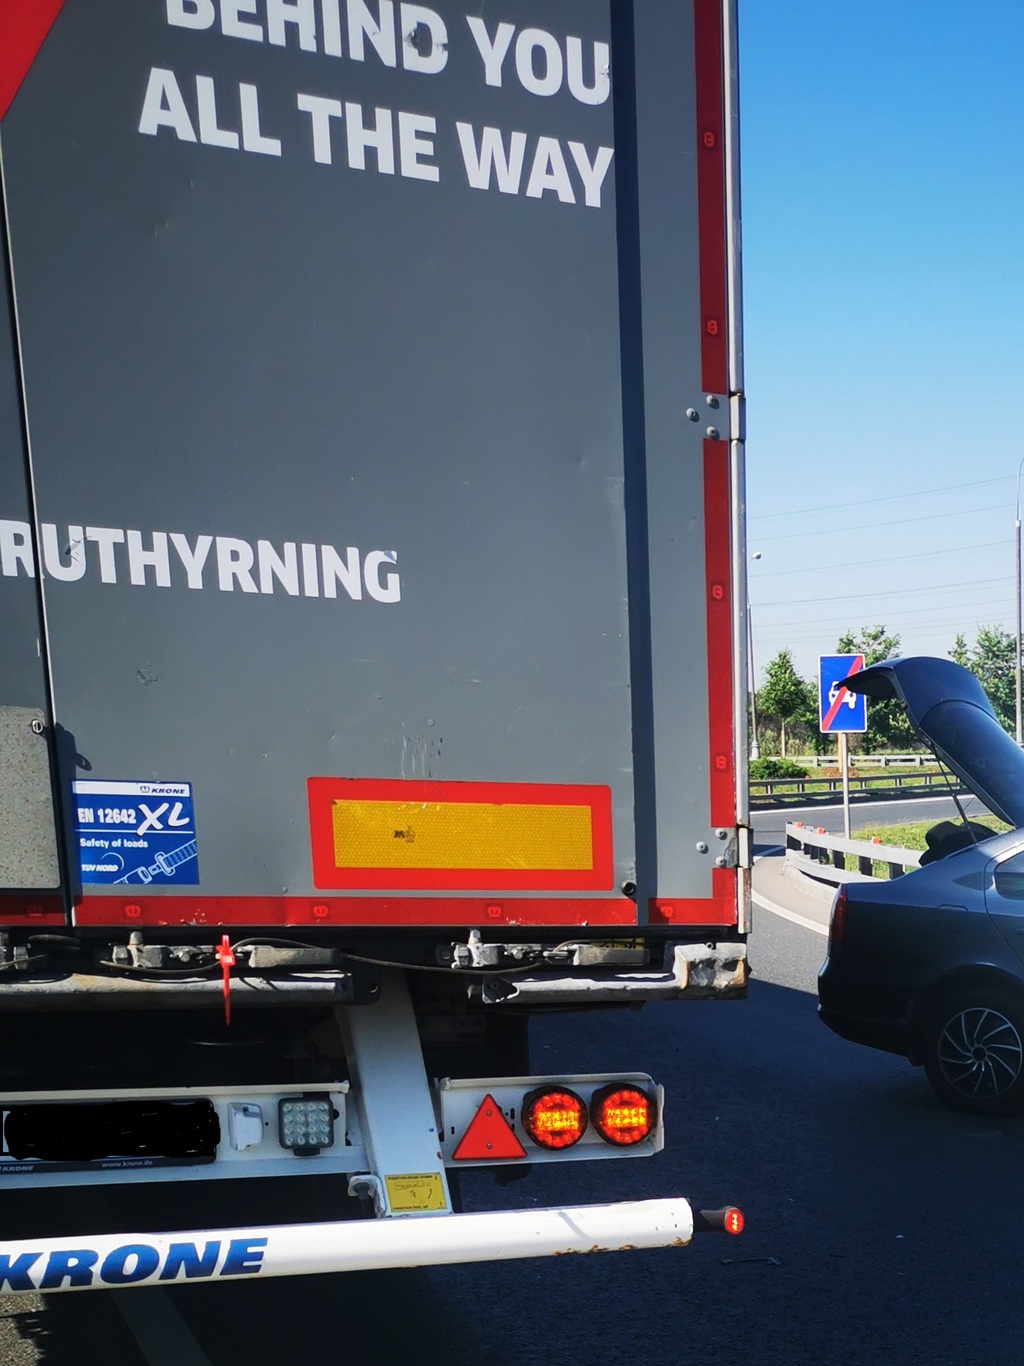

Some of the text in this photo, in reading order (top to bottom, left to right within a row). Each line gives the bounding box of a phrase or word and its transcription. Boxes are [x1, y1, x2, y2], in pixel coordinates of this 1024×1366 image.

[466, 15, 611, 105] YOU
[138, 66, 614, 208] ALL THE WAY
[0, 519, 401, 604] RUTHYRNING
[77, 802, 190, 836] EN 12642 XL
[80, 838, 149, 849] Safety of loads
[102, 1160, 153, 1168] www.krone.de
[0, 1237, 268, 1291] KRONE
